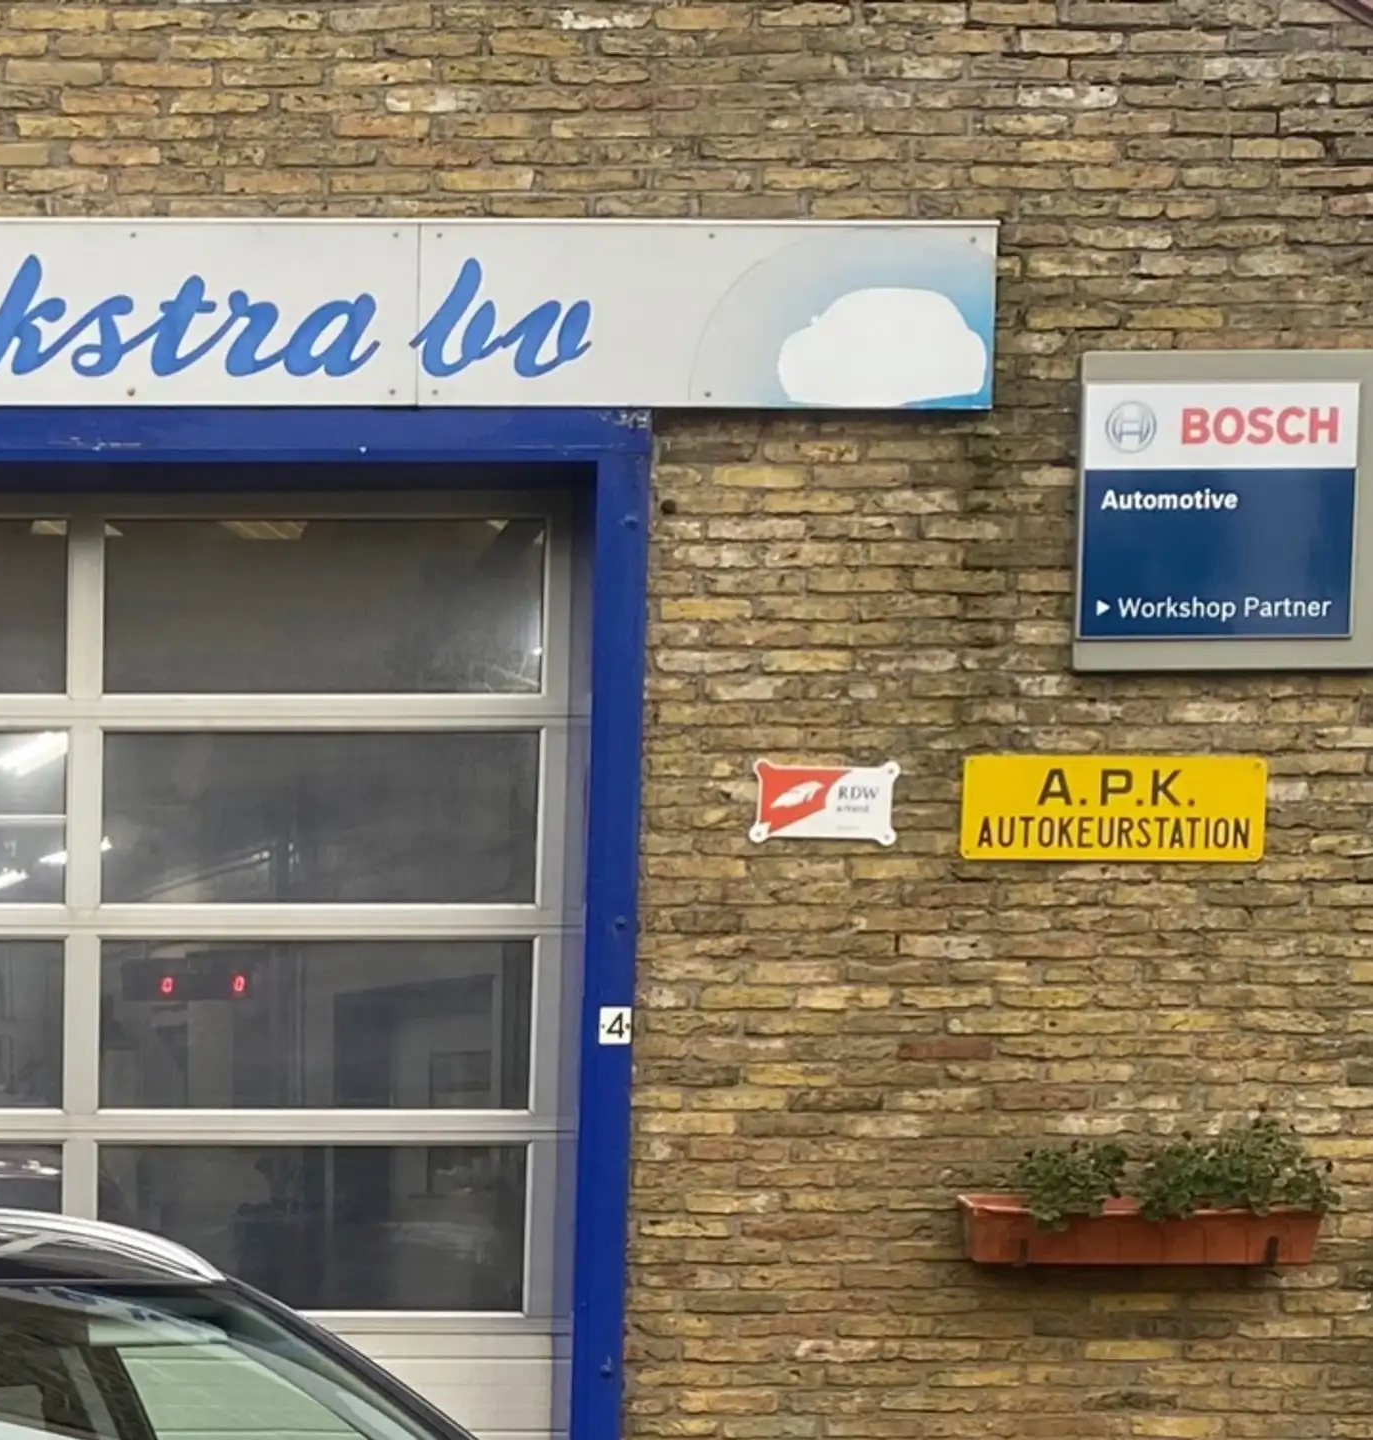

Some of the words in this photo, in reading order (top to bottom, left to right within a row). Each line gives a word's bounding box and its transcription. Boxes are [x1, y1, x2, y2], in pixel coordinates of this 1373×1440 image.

[409, 258, 593, 378] bv
[1180, 406, 1340, 446] BOSCH
[1100, 487, 1240, 511] Automotive
[1118, 597, 1237, 622] Workshop
[1243, 597, 1333, 619] Partner
[838, 786, 880, 800] RDW
[1037, 768, 1196, 806] A.P.K.
[977, 815, 1251, 850] AUTOKEURSTATION
[606, 1012, 625, 1039] 4
